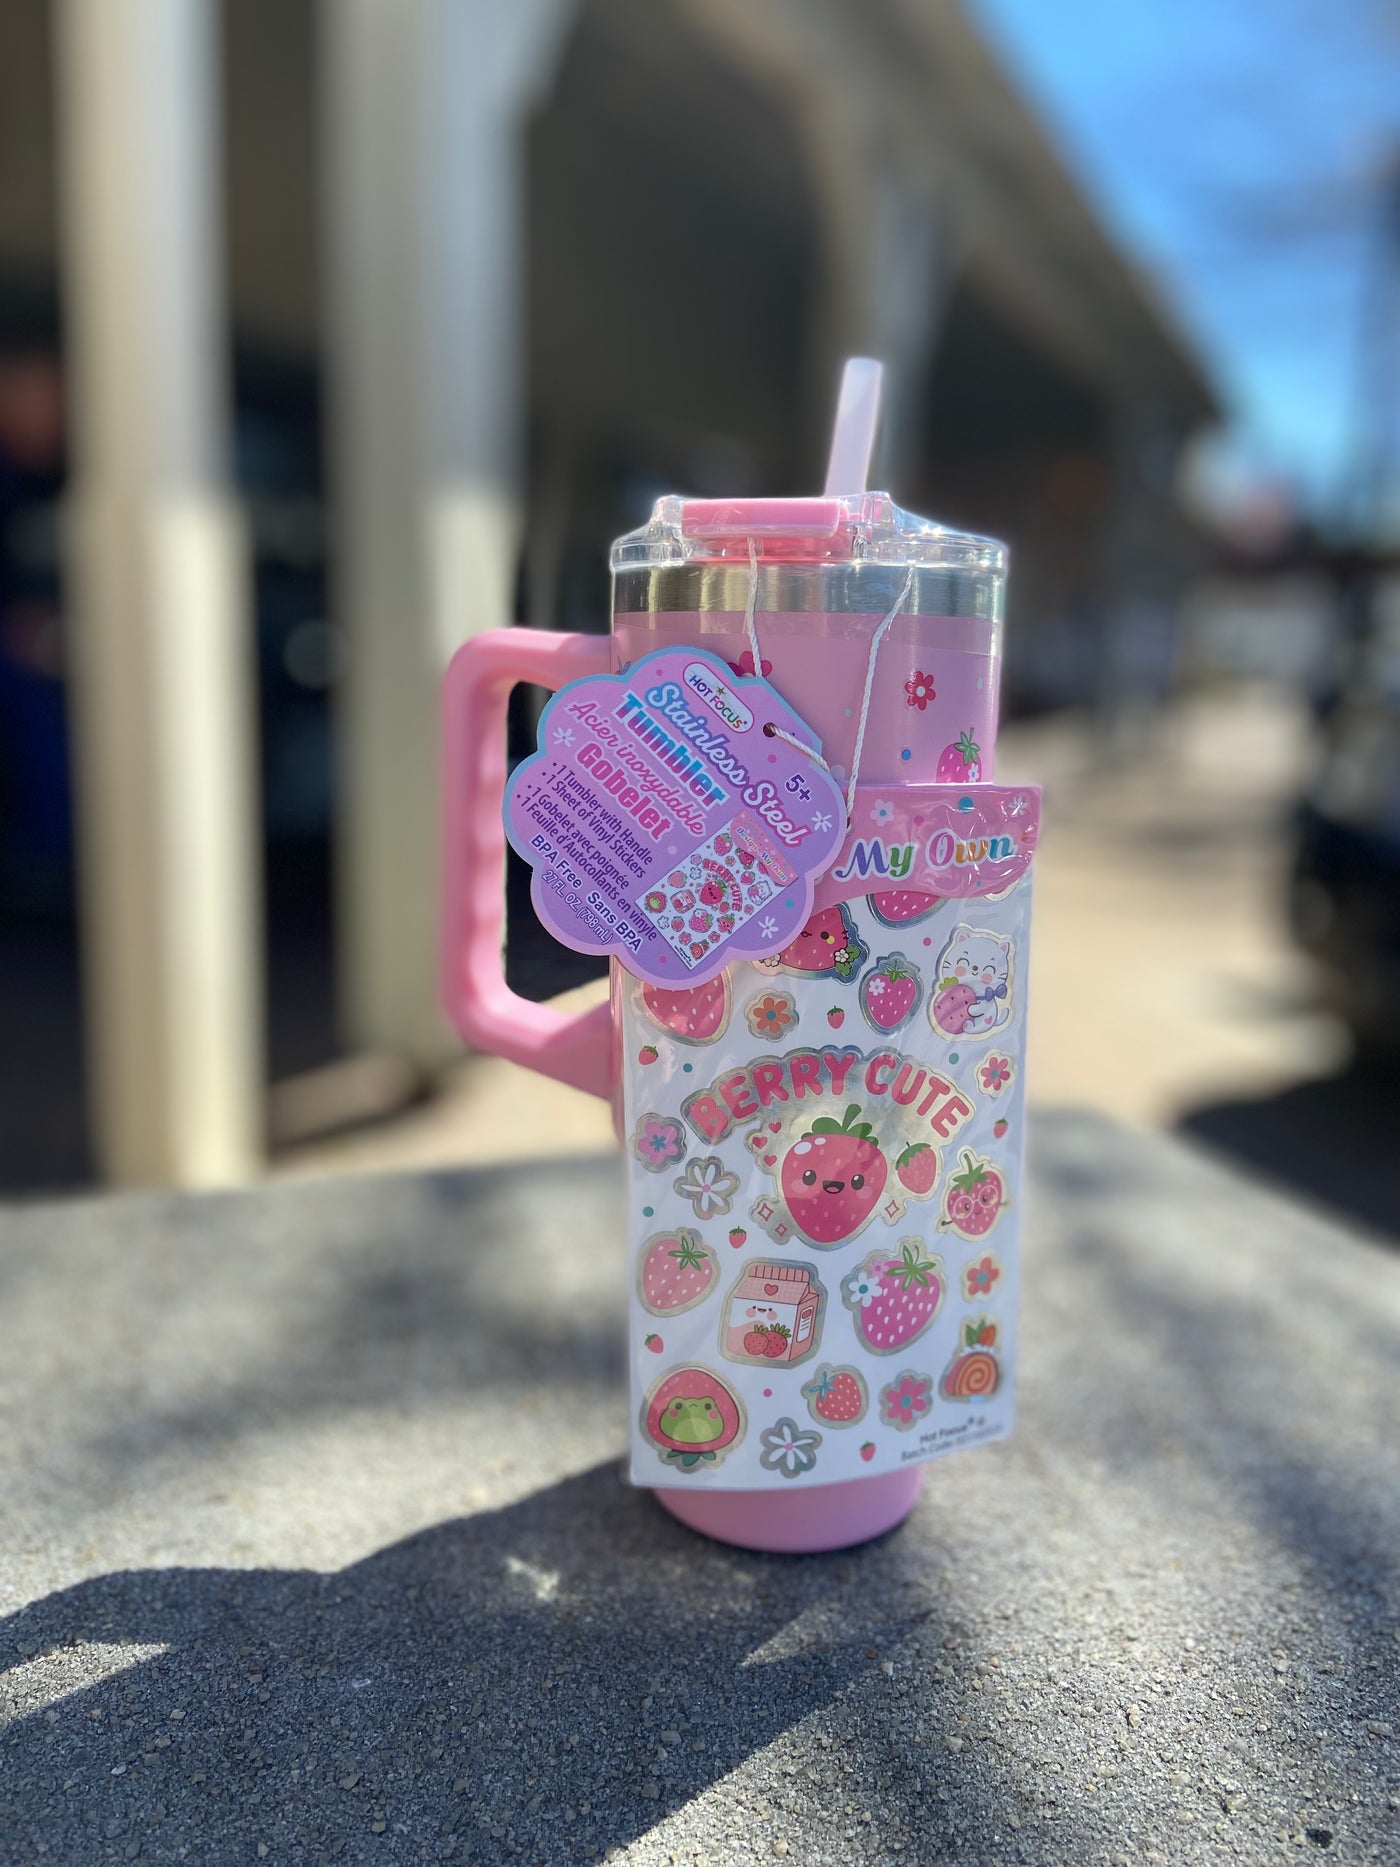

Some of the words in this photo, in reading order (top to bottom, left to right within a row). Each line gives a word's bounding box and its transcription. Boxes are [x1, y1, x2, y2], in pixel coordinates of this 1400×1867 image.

[688, 674, 713, 698] HOT
[566, 701, 619, 749] Acier
[616, 743, 705, 836] inoxydable
[576, 742, 672, 841] Gobelet
[613, 691, 728, 808] Tumbler
[646, 683, 748, 787] Stainless
[743, 781, 811, 846] Steel
[785, 773, 812, 802] 5+
[531, 787, 542, 798] 1
[537, 794, 576, 833] Gobelet
[571, 829, 595, 853] avec
[588, 849, 630, 891] poignée
[546, 774, 556, 785] 1
[551, 780, 581, 812] Sheet
[577, 806, 594, 823] of
[588, 814, 614, 844] Vinyl
[609, 839, 646, 879] Stickers
[556, 764, 567, 775] 1
[563, 770, 603, 811] Tumbler
[599, 807, 622, 833] with
[620, 828, 653, 866] Handle
[834, 839, 915, 879] My
[928, 831, 1017, 867] Own
[521, 797, 531, 808] 1
[526, 802, 559, 838] Feuille
[617, 898, 631, 914] en
[629, 910, 657, 942] vinyle
[531, 834, 558, 864] BPA
[556, 860, 583, 890] Free
[542, 870, 555, 884] 27
[576, 906, 600, 929] (798
[592, 924, 614, 946] mL)
[701, 857, 736, 884] BERRY
[729, 882, 743, 912] CUTE
[587, 891, 618, 925] Sans
[614, 920, 643, 952] BPA
[689, 1053, 856, 1138] BERRY
[864, 1054, 970, 1138] CUTE
